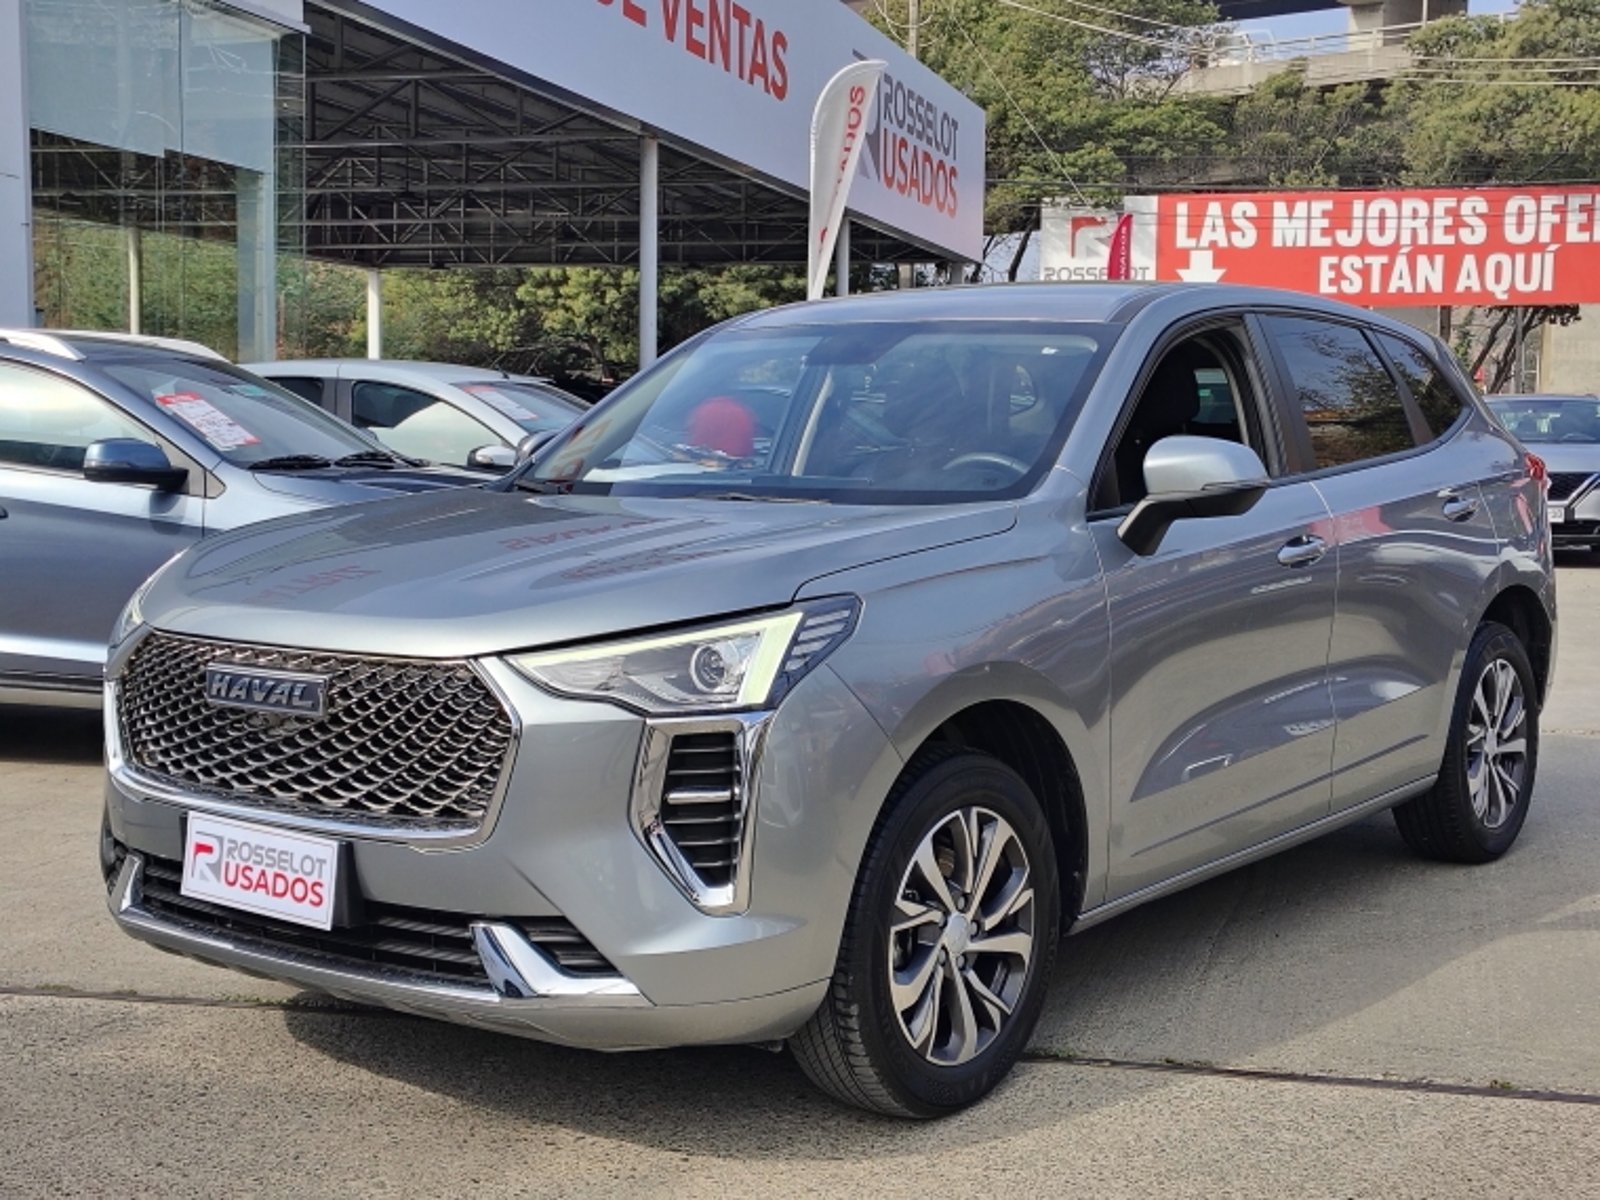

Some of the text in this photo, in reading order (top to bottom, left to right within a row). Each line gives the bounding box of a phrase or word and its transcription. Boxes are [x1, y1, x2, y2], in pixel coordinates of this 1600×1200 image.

[662, 0, 788, 101] VENTAS
[883, 73, 959, 160] ROSSELOT
[883, 127, 958, 218] USADOS
[1175, 201, 1259, 248] LAS
[1271, 195, 1489, 248] MEJORES
[1318, 243, 1562, 300] ESTÁN AQUÍ
[210, 673, 314, 708] HAVAL
[224, 860, 324, 908] USADOS
[226, 839, 327, 879] ROSSELOT
